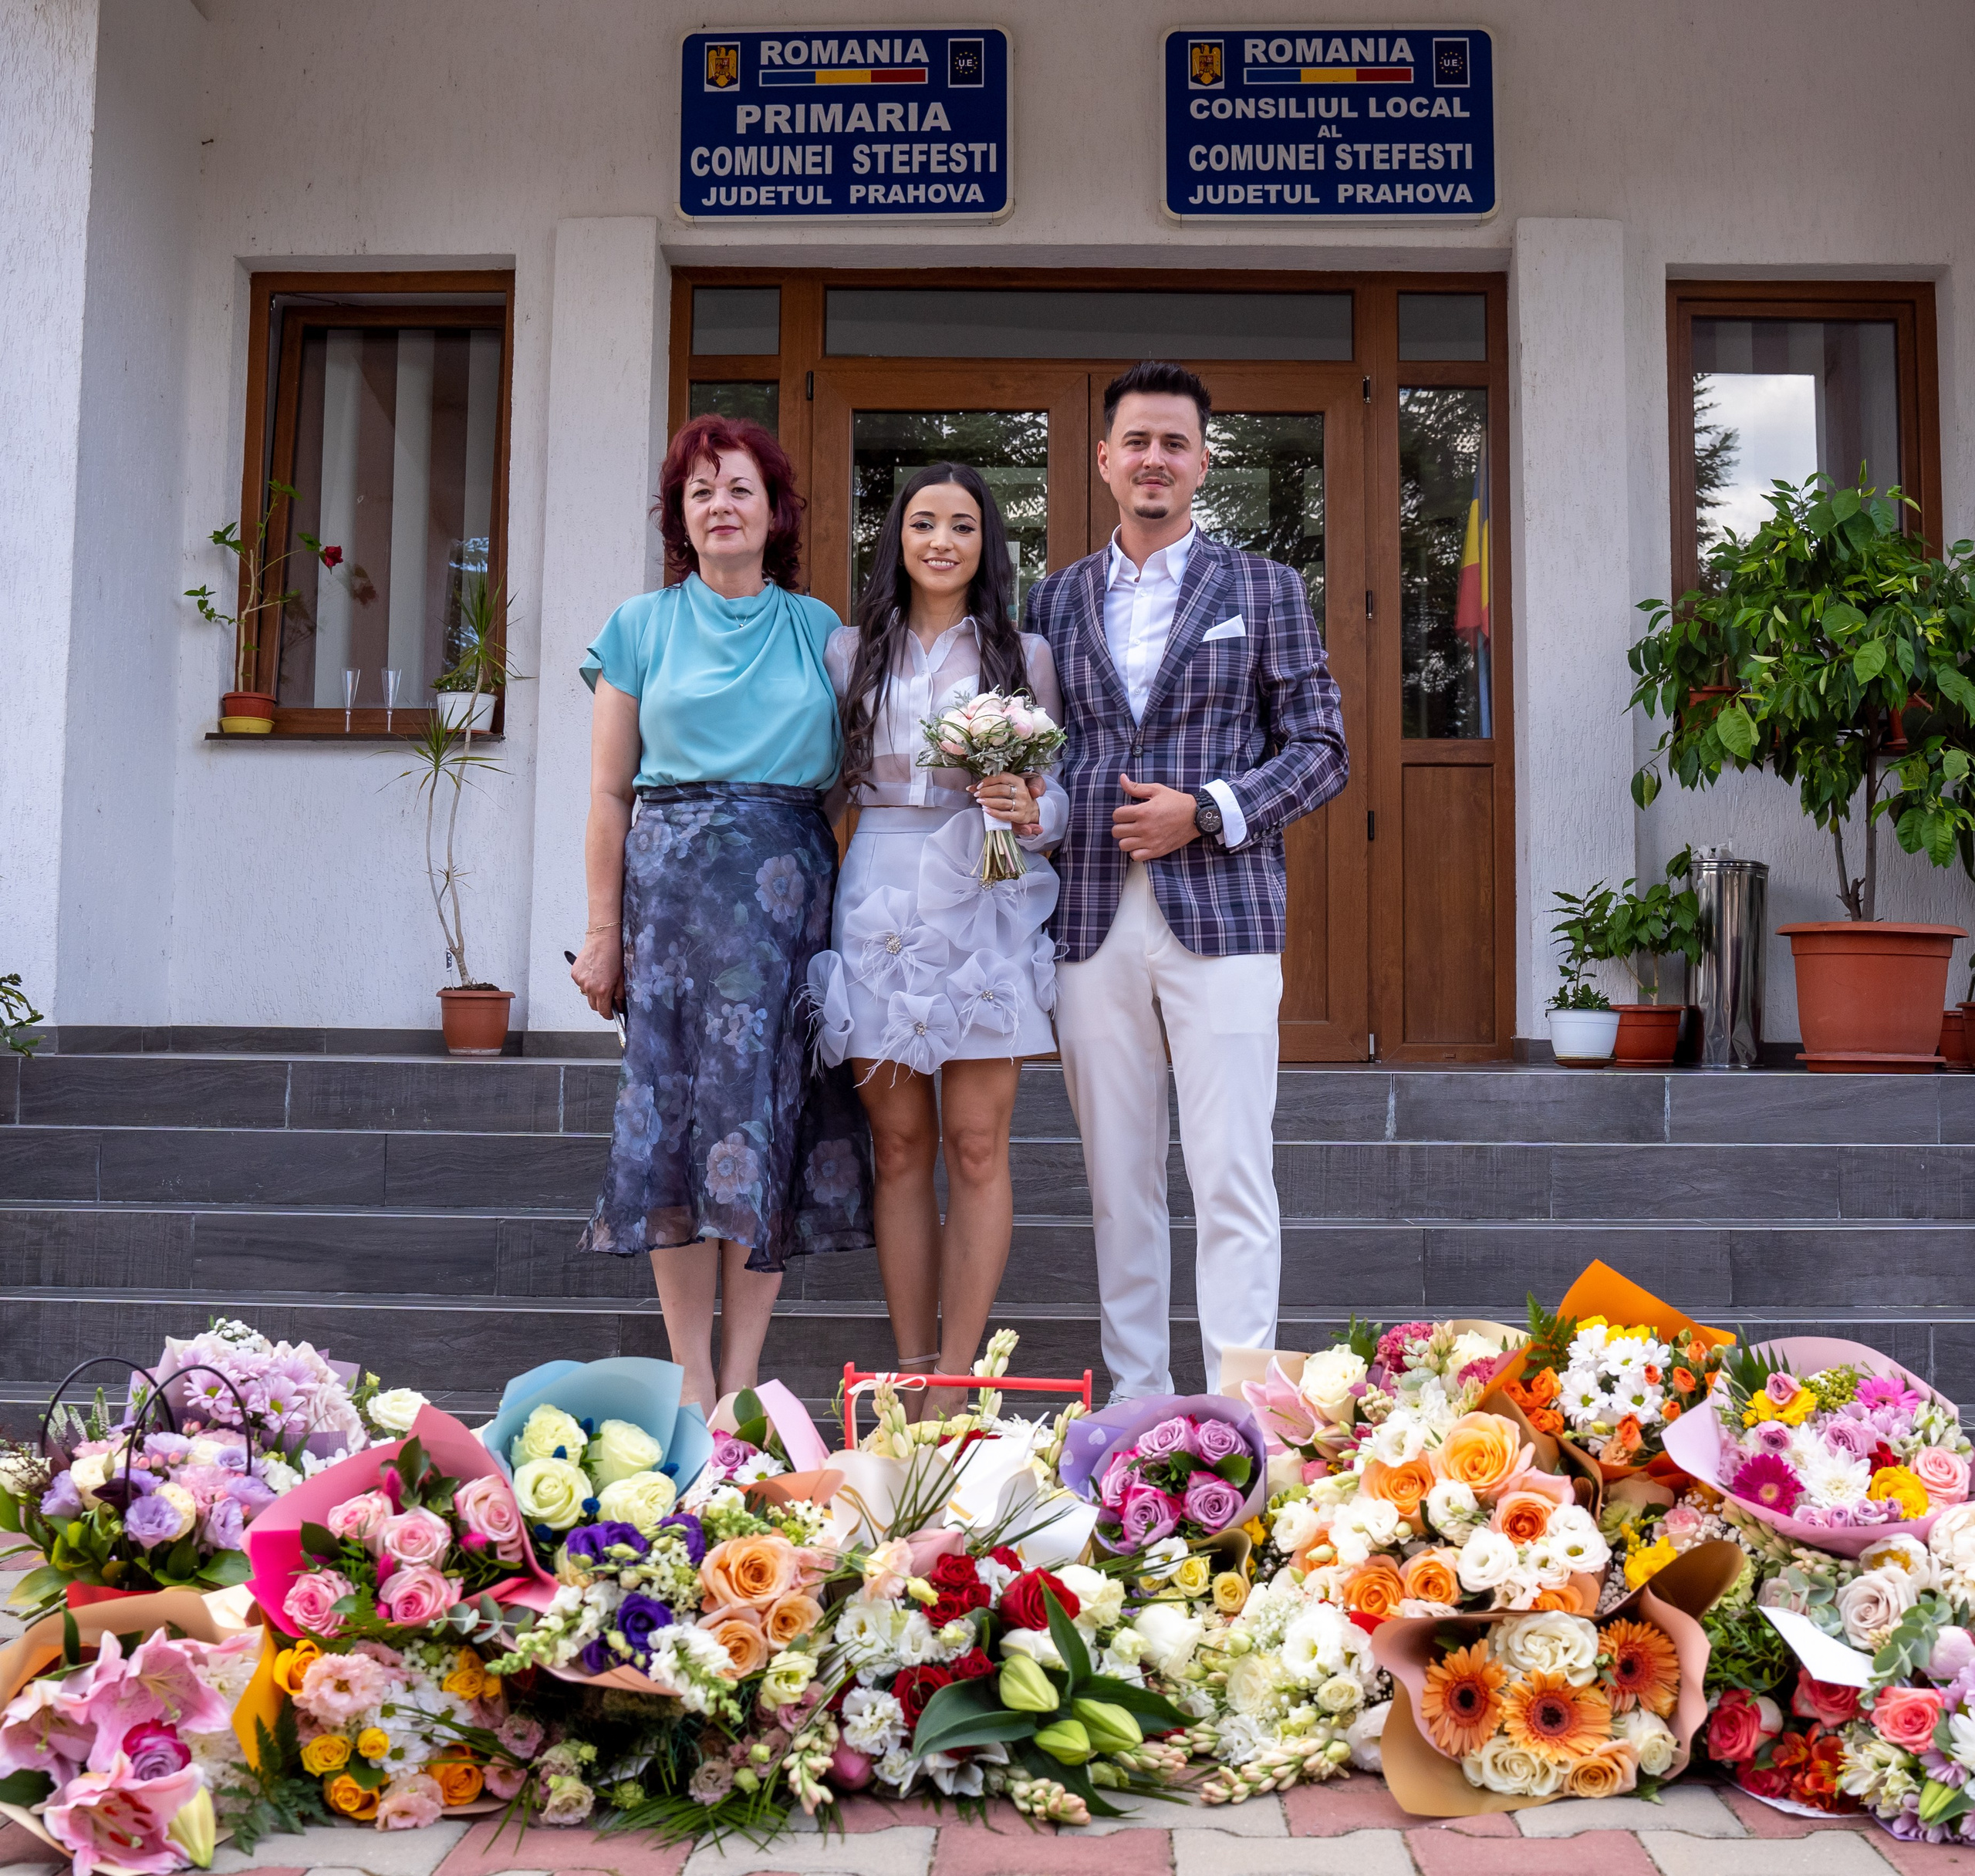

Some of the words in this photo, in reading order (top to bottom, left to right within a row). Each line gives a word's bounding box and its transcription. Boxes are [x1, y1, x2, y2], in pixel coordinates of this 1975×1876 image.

[761, 39, 929, 65] ROMANIA
[1244, 38, 1414, 62] ROMANIA
[737, 103, 951, 133] PRIMARIA
[1190, 98, 1358, 119] CONSILIUL
[1369, 97, 1470, 117] LOCAL
[1318, 125, 1342, 137] AL
[691, 145, 832, 176] COMUNEI
[852, 143, 996, 174] STEFESTI
[1189, 144, 1324, 170] COMUNEI
[1335, 143, 1472, 170] STEFESTI
[702, 186, 832, 206] JUDETUL
[850, 184, 984, 204] PRAHOVA
[1189, 184, 1319, 204] JUDETUL
[1339, 184, 1473, 203] PRAHOVA
